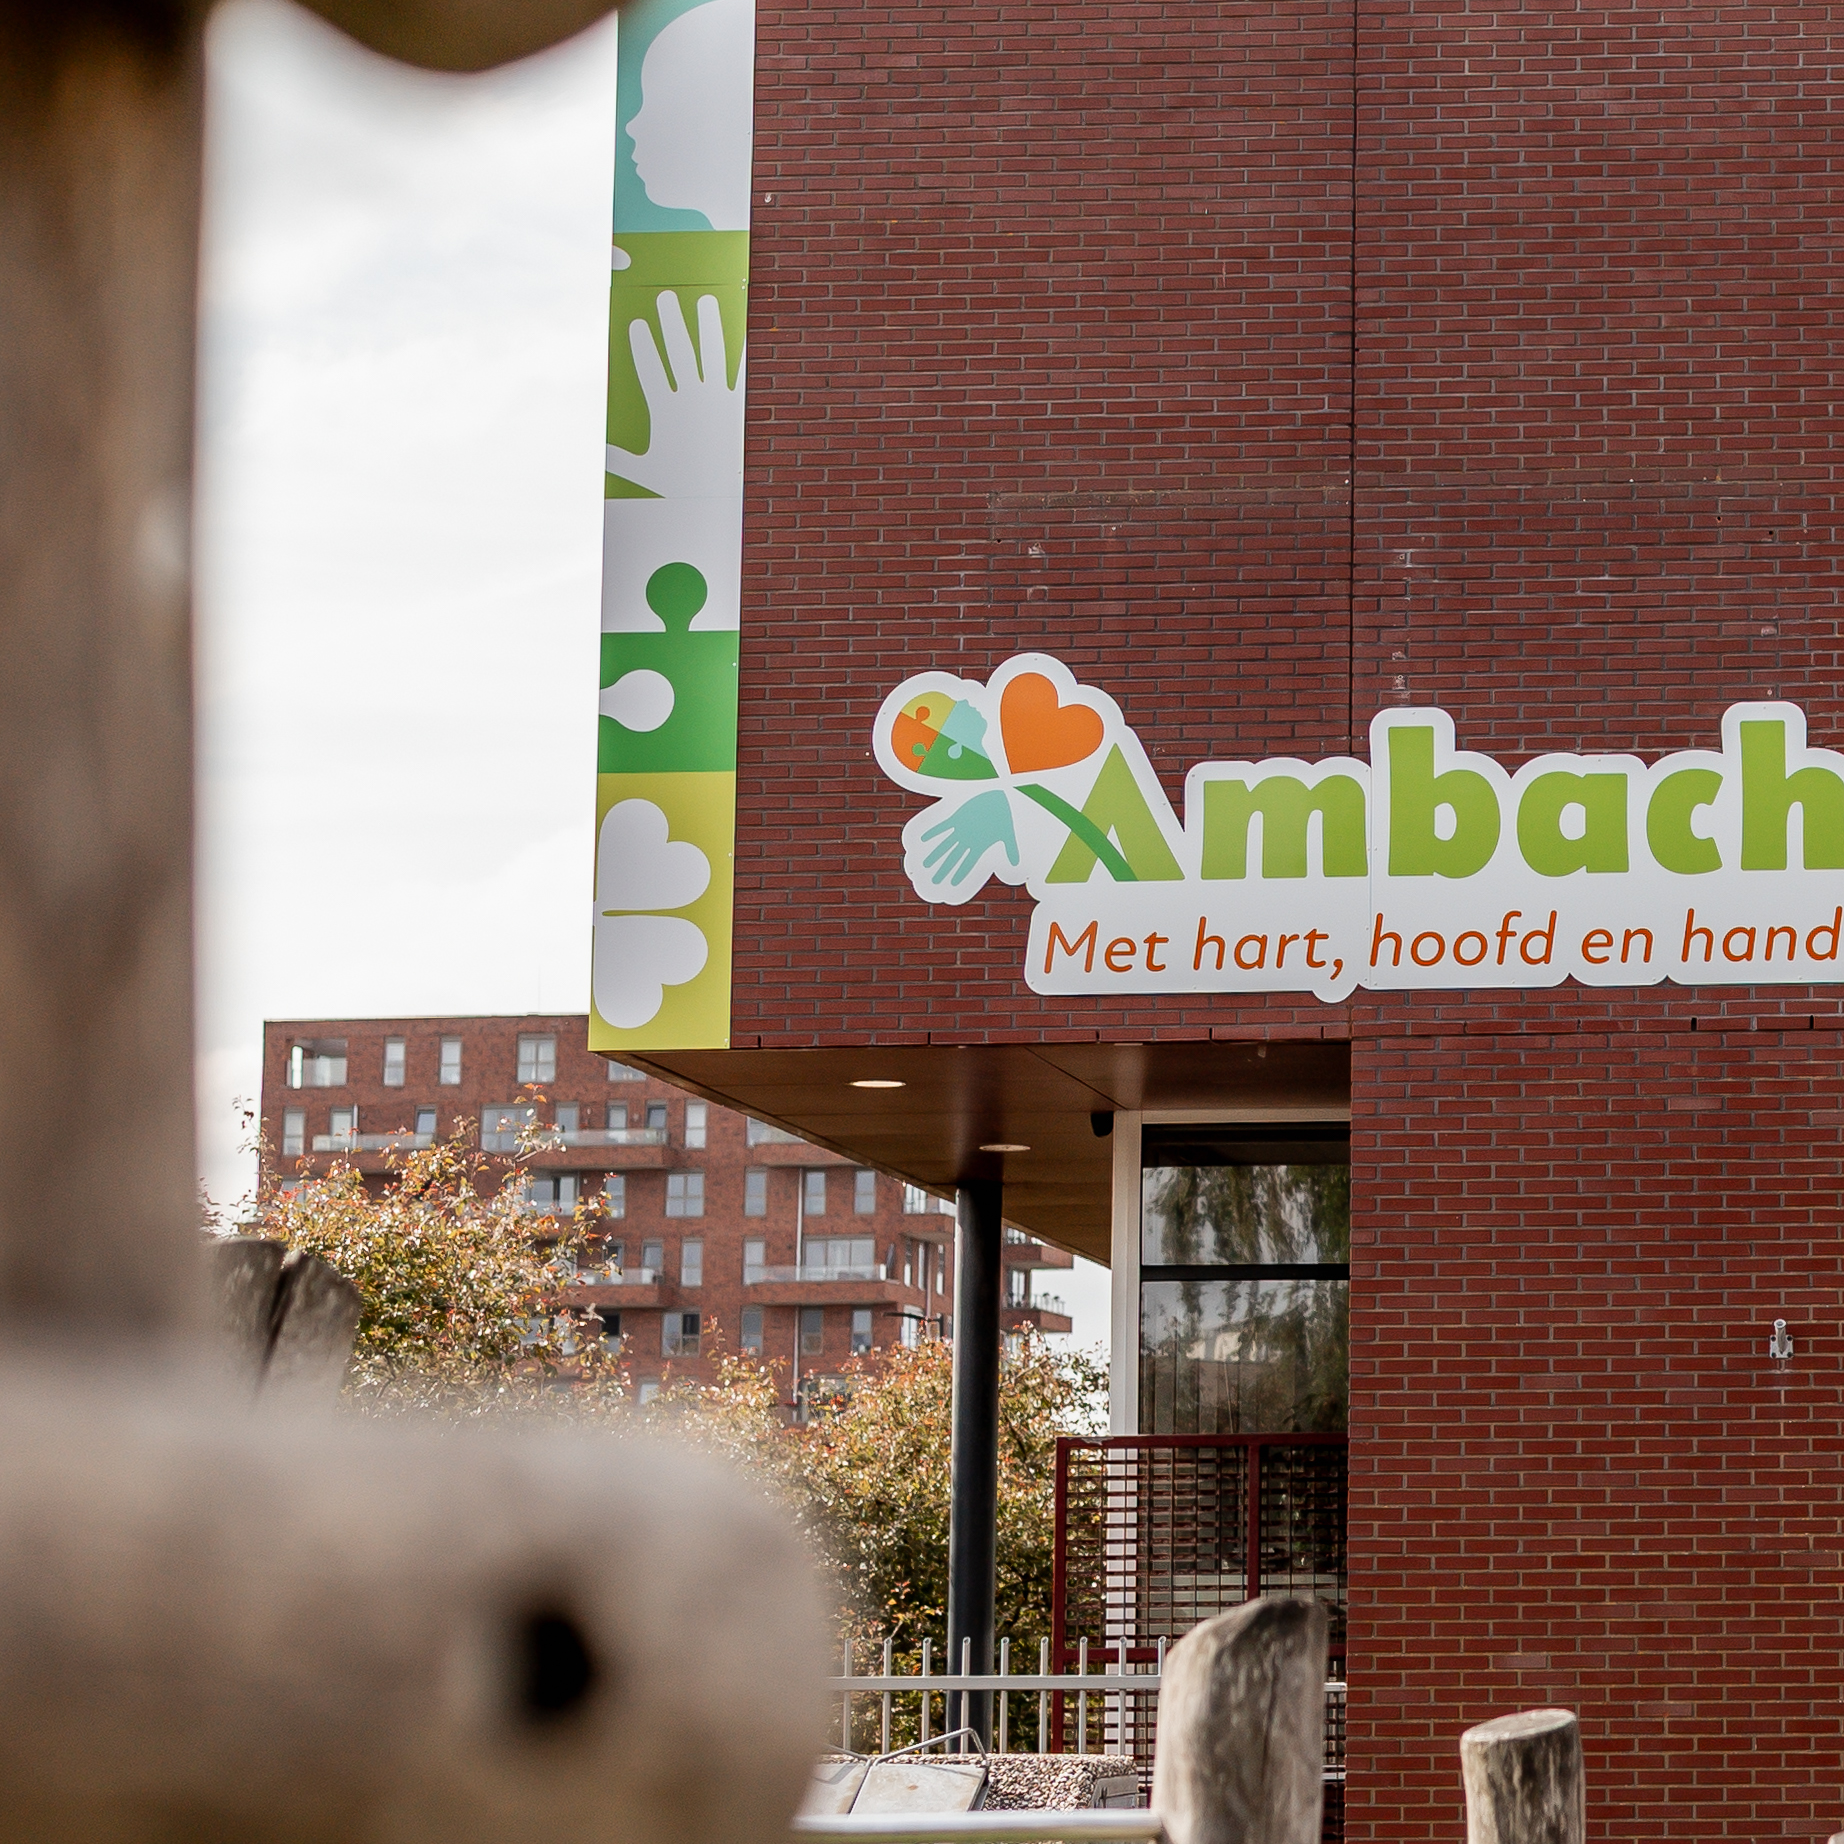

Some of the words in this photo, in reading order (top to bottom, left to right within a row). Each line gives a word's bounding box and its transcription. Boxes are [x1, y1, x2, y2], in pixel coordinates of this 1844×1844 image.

[1043, 919, 1169, 974] Met
[1193, 916, 1345, 982] hart,
[1370, 910, 1557, 967] hoofd
[1580, 929, 1653, 965] en
